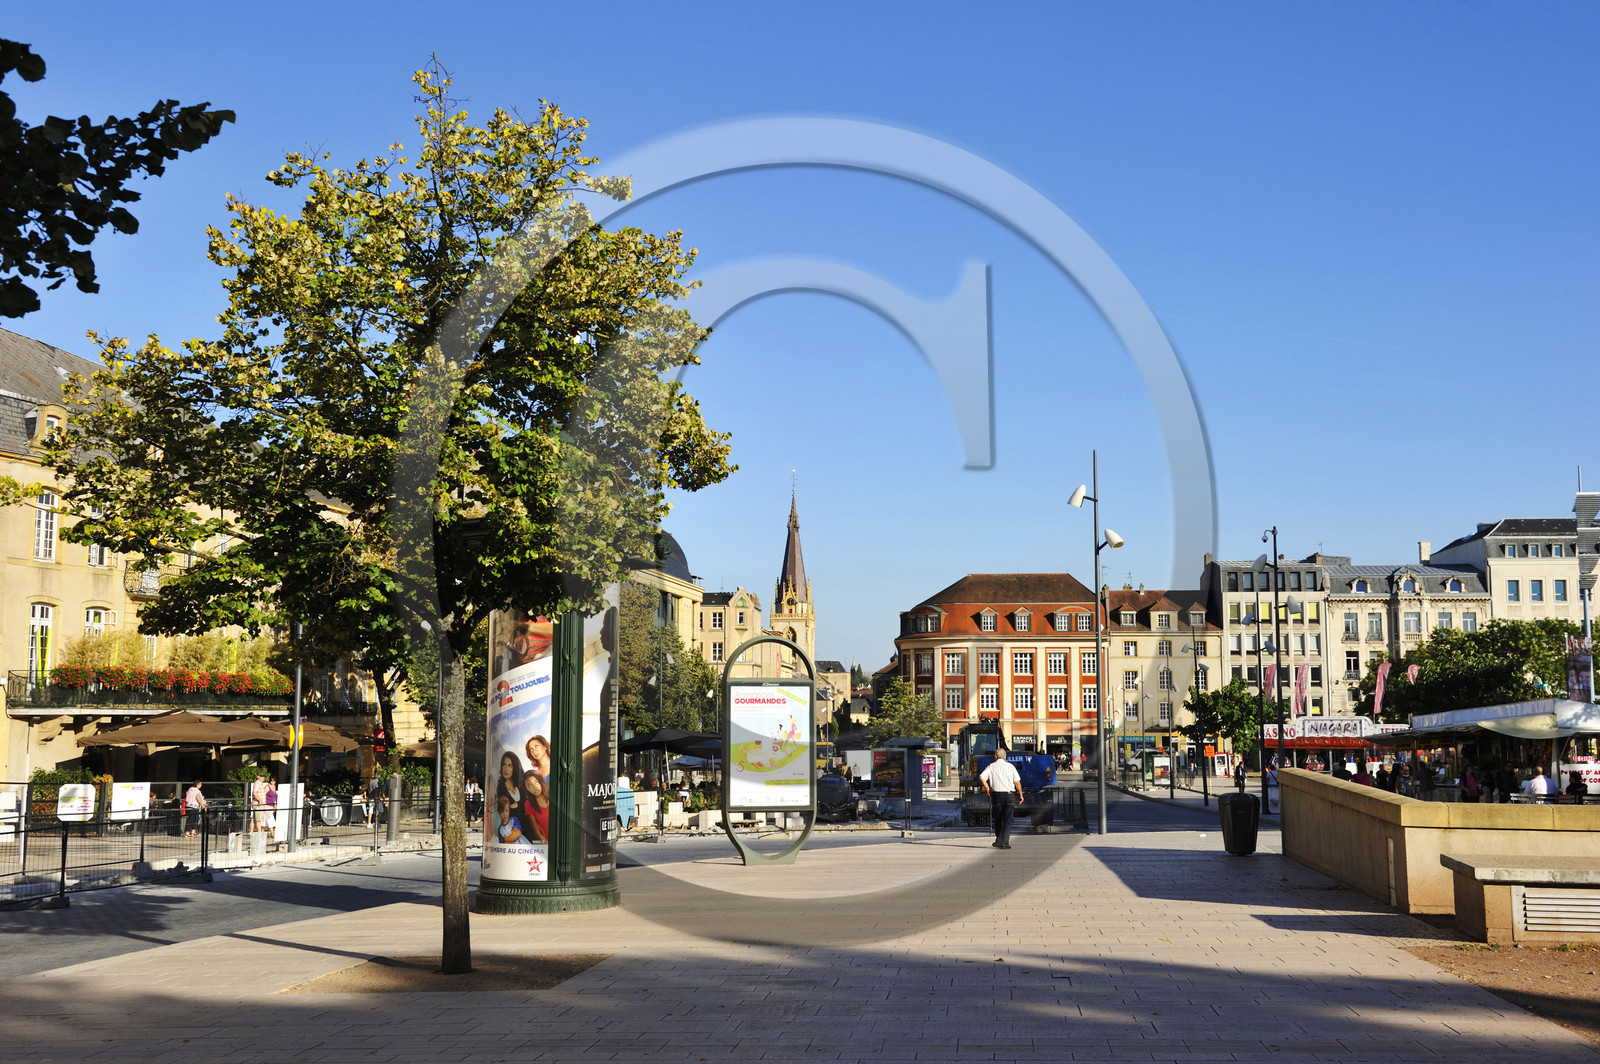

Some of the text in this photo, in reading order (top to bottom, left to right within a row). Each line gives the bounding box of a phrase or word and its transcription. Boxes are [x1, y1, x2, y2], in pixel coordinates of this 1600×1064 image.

[510, 675, 550, 694] TOUJOURS
[1259, 728, 1296, 738] ASNO
[1308, 722, 1358, 735] NIAGARA
